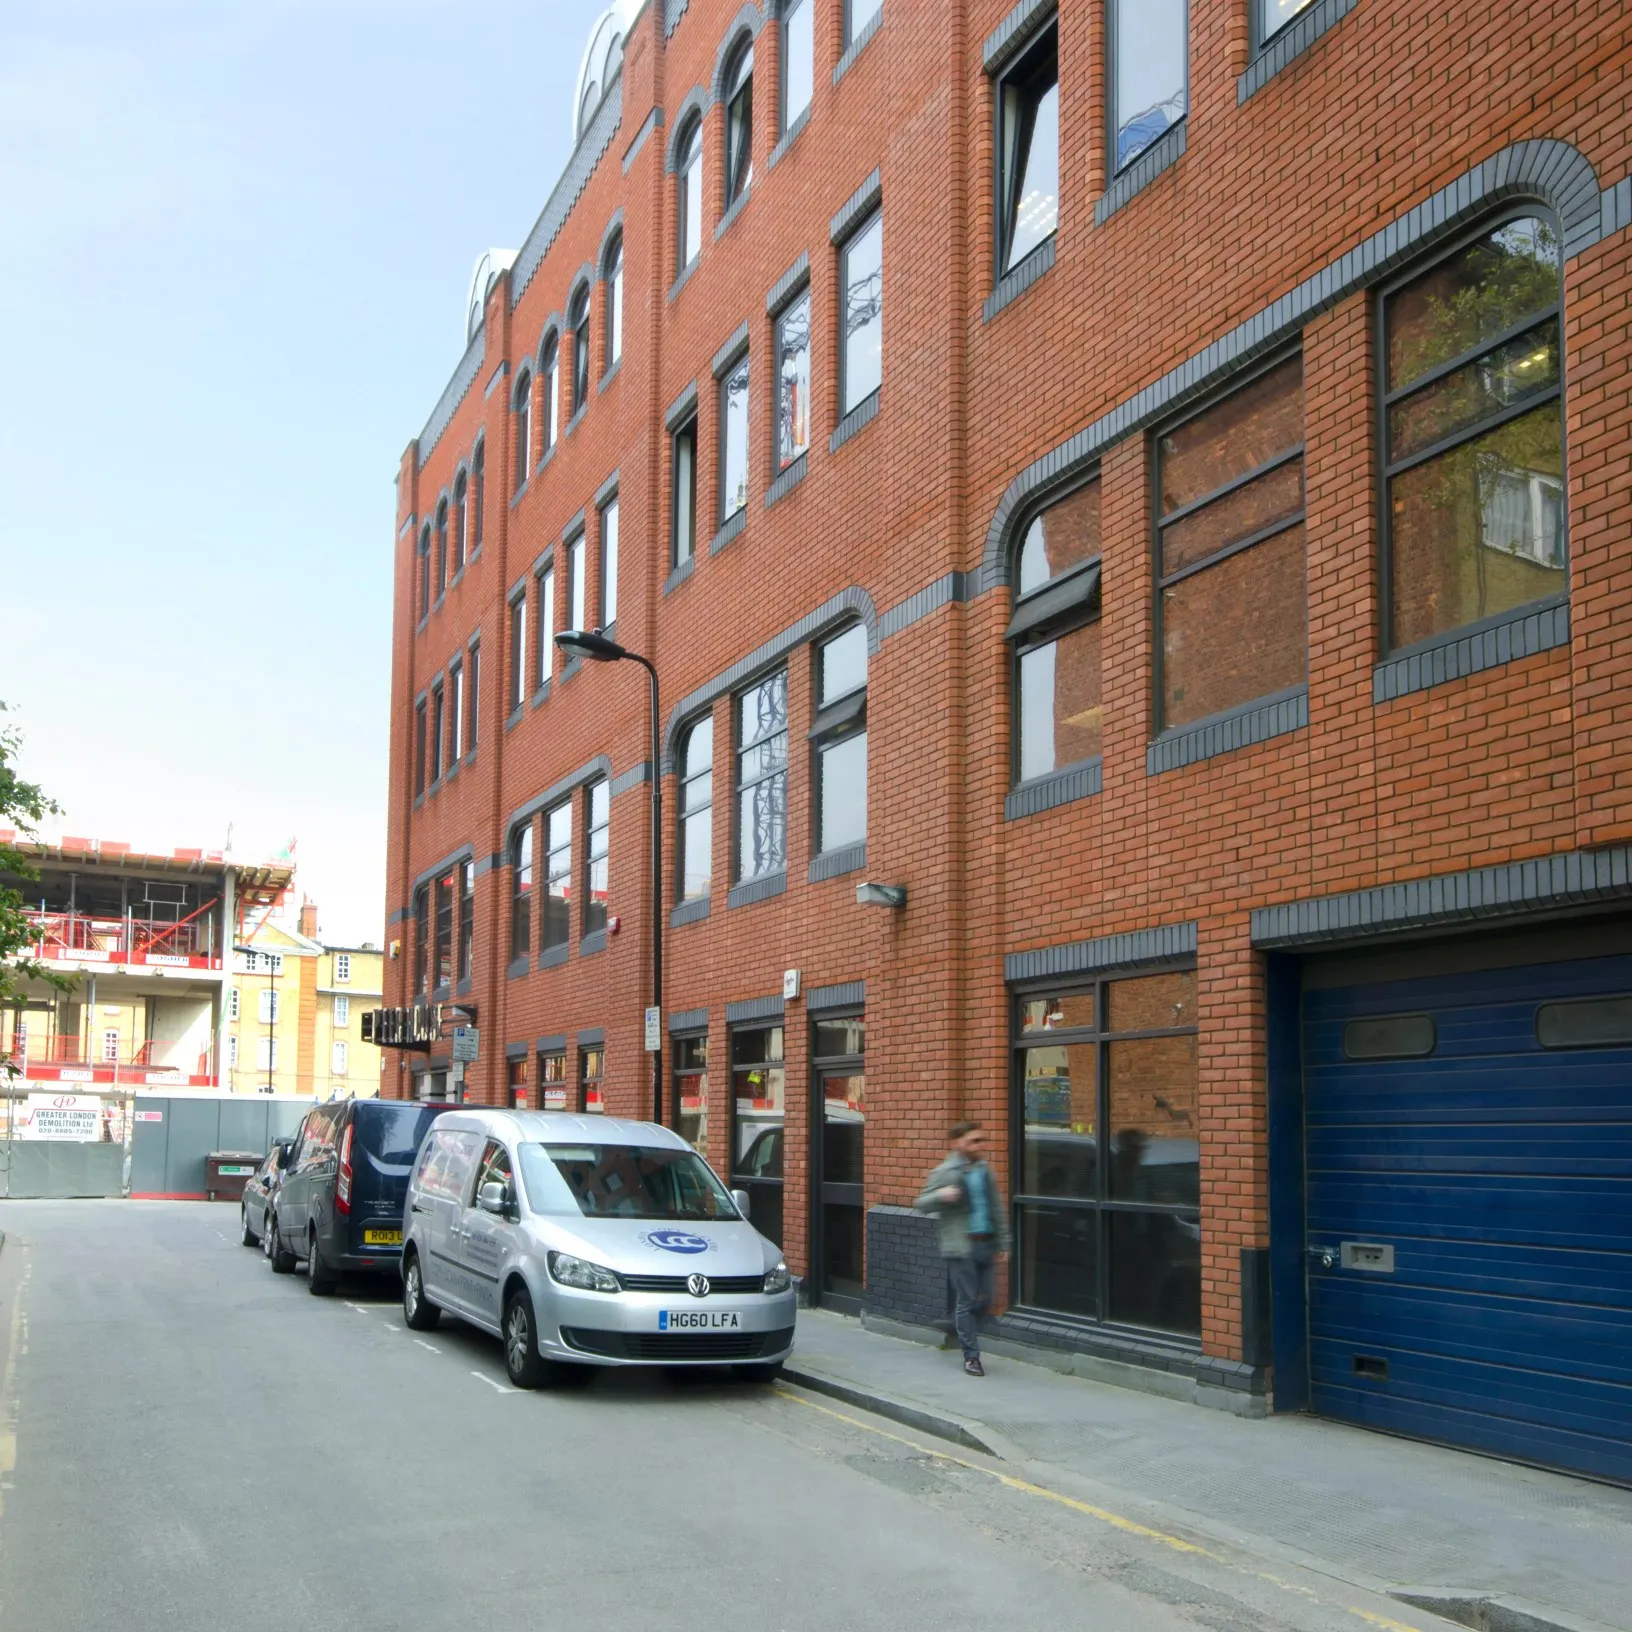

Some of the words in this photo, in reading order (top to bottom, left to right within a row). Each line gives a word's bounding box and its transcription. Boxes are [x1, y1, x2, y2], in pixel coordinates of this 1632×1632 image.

[36, 1111, 67, 1119] GREATER
[69, 1112, 97, 1120] LONDON
[38, 1119, 81, 1127] DEMOLITION
[371, 1231, 395, 1241] RO13
[670, 1313, 708, 1327] HG60
[712, 1313, 738, 1327] LFA
